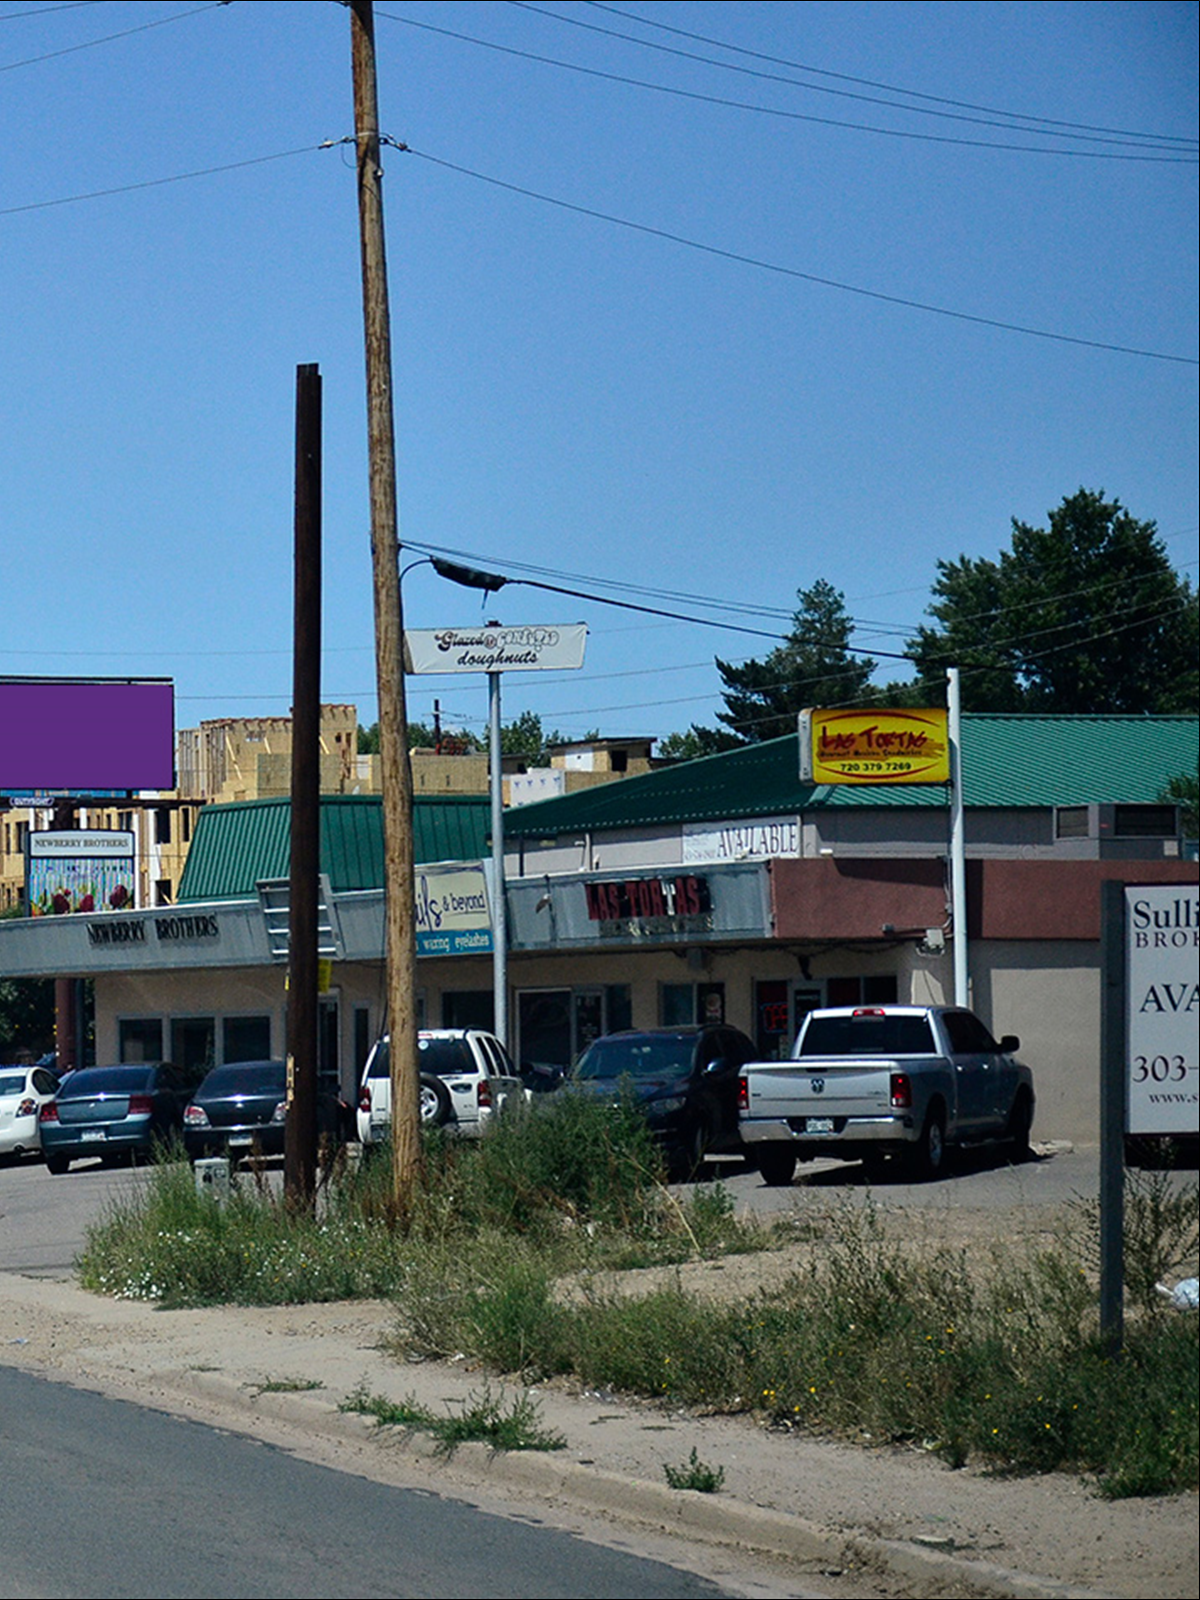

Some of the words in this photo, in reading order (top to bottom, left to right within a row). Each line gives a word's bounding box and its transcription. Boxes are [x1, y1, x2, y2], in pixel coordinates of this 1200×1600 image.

[457, 648, 539, 669] doughnuts
[821, 726, 856, 750] LAS
[859, 726, 928, 749] TORTAS
[840, 763, 861, 772] 720
[717, 823, 798, 857] AVAILABLE
[625, 876, 700, 918] TORTAS
[86, 920, 145, 943] NEWBERRY
[155, 914, 219, 940] BROTHERS
